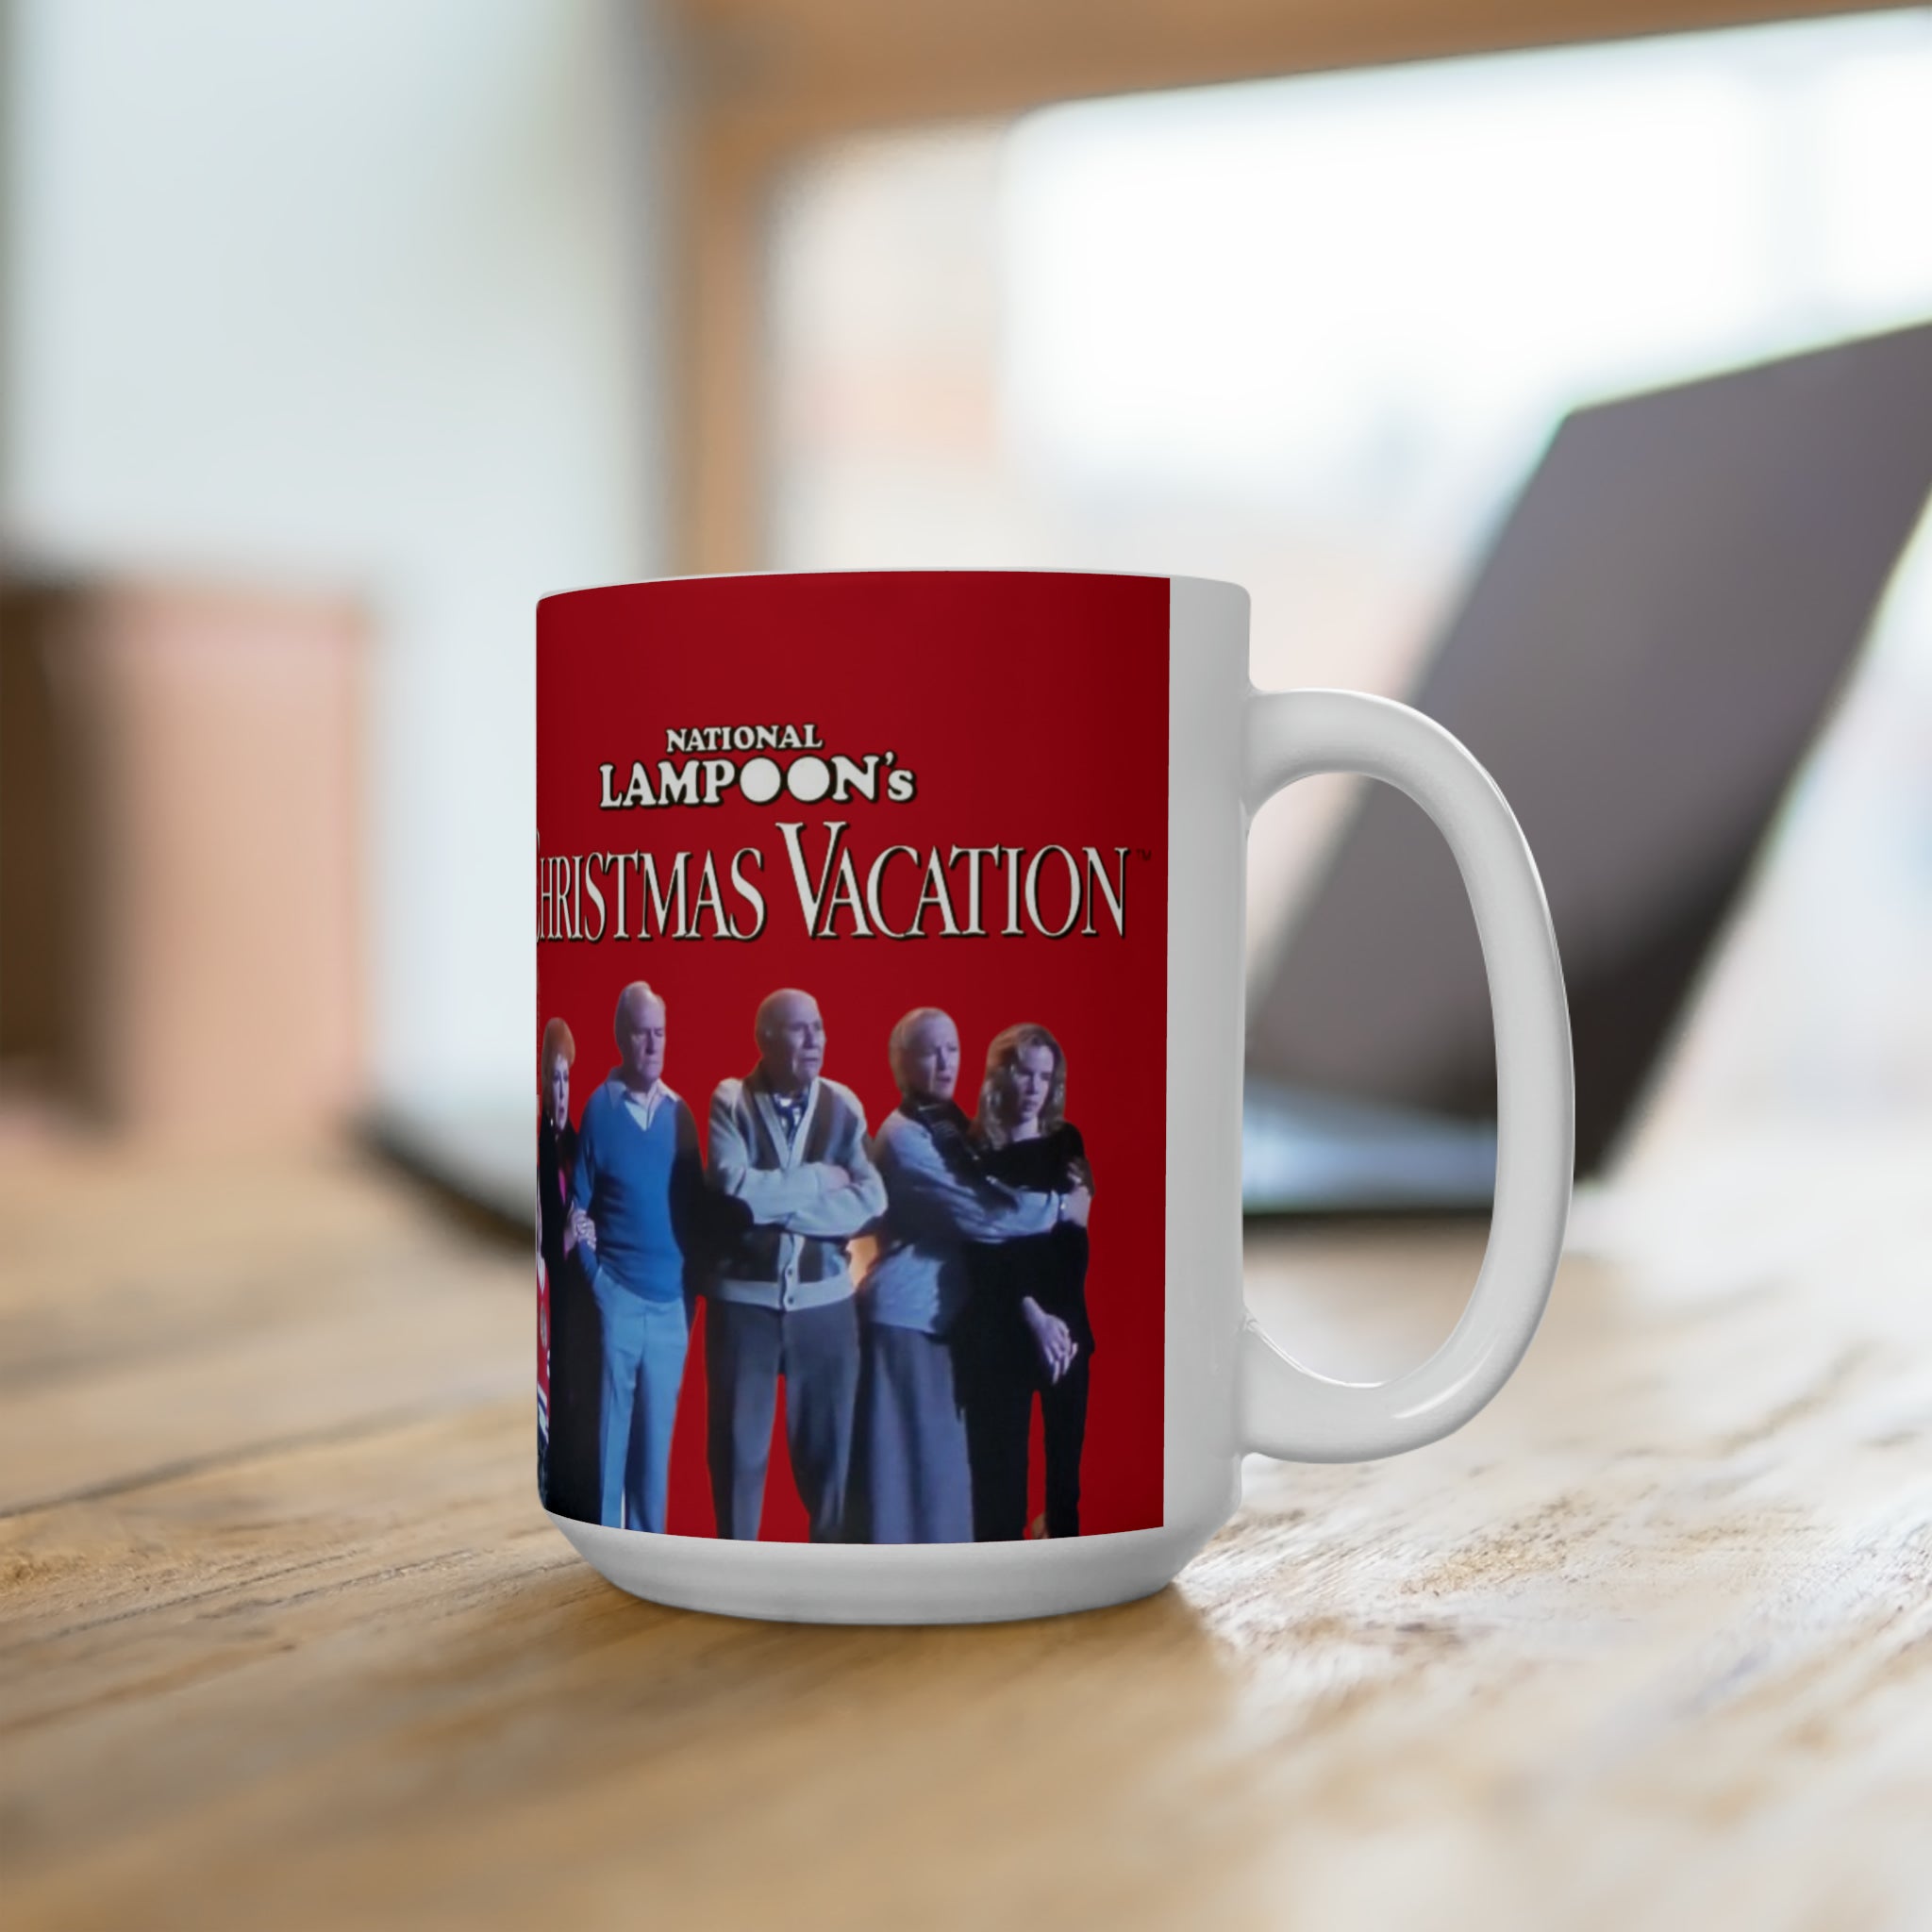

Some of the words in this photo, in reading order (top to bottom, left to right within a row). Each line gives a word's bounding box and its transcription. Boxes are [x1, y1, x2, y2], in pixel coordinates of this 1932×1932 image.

[665, 724, 823, 753] NATIONAL
[599, 751, 917, 808] LAMPOON's
[537, 827, 767, 943] HRISTMAS
[775, 820, 1129, 939] VACATION
